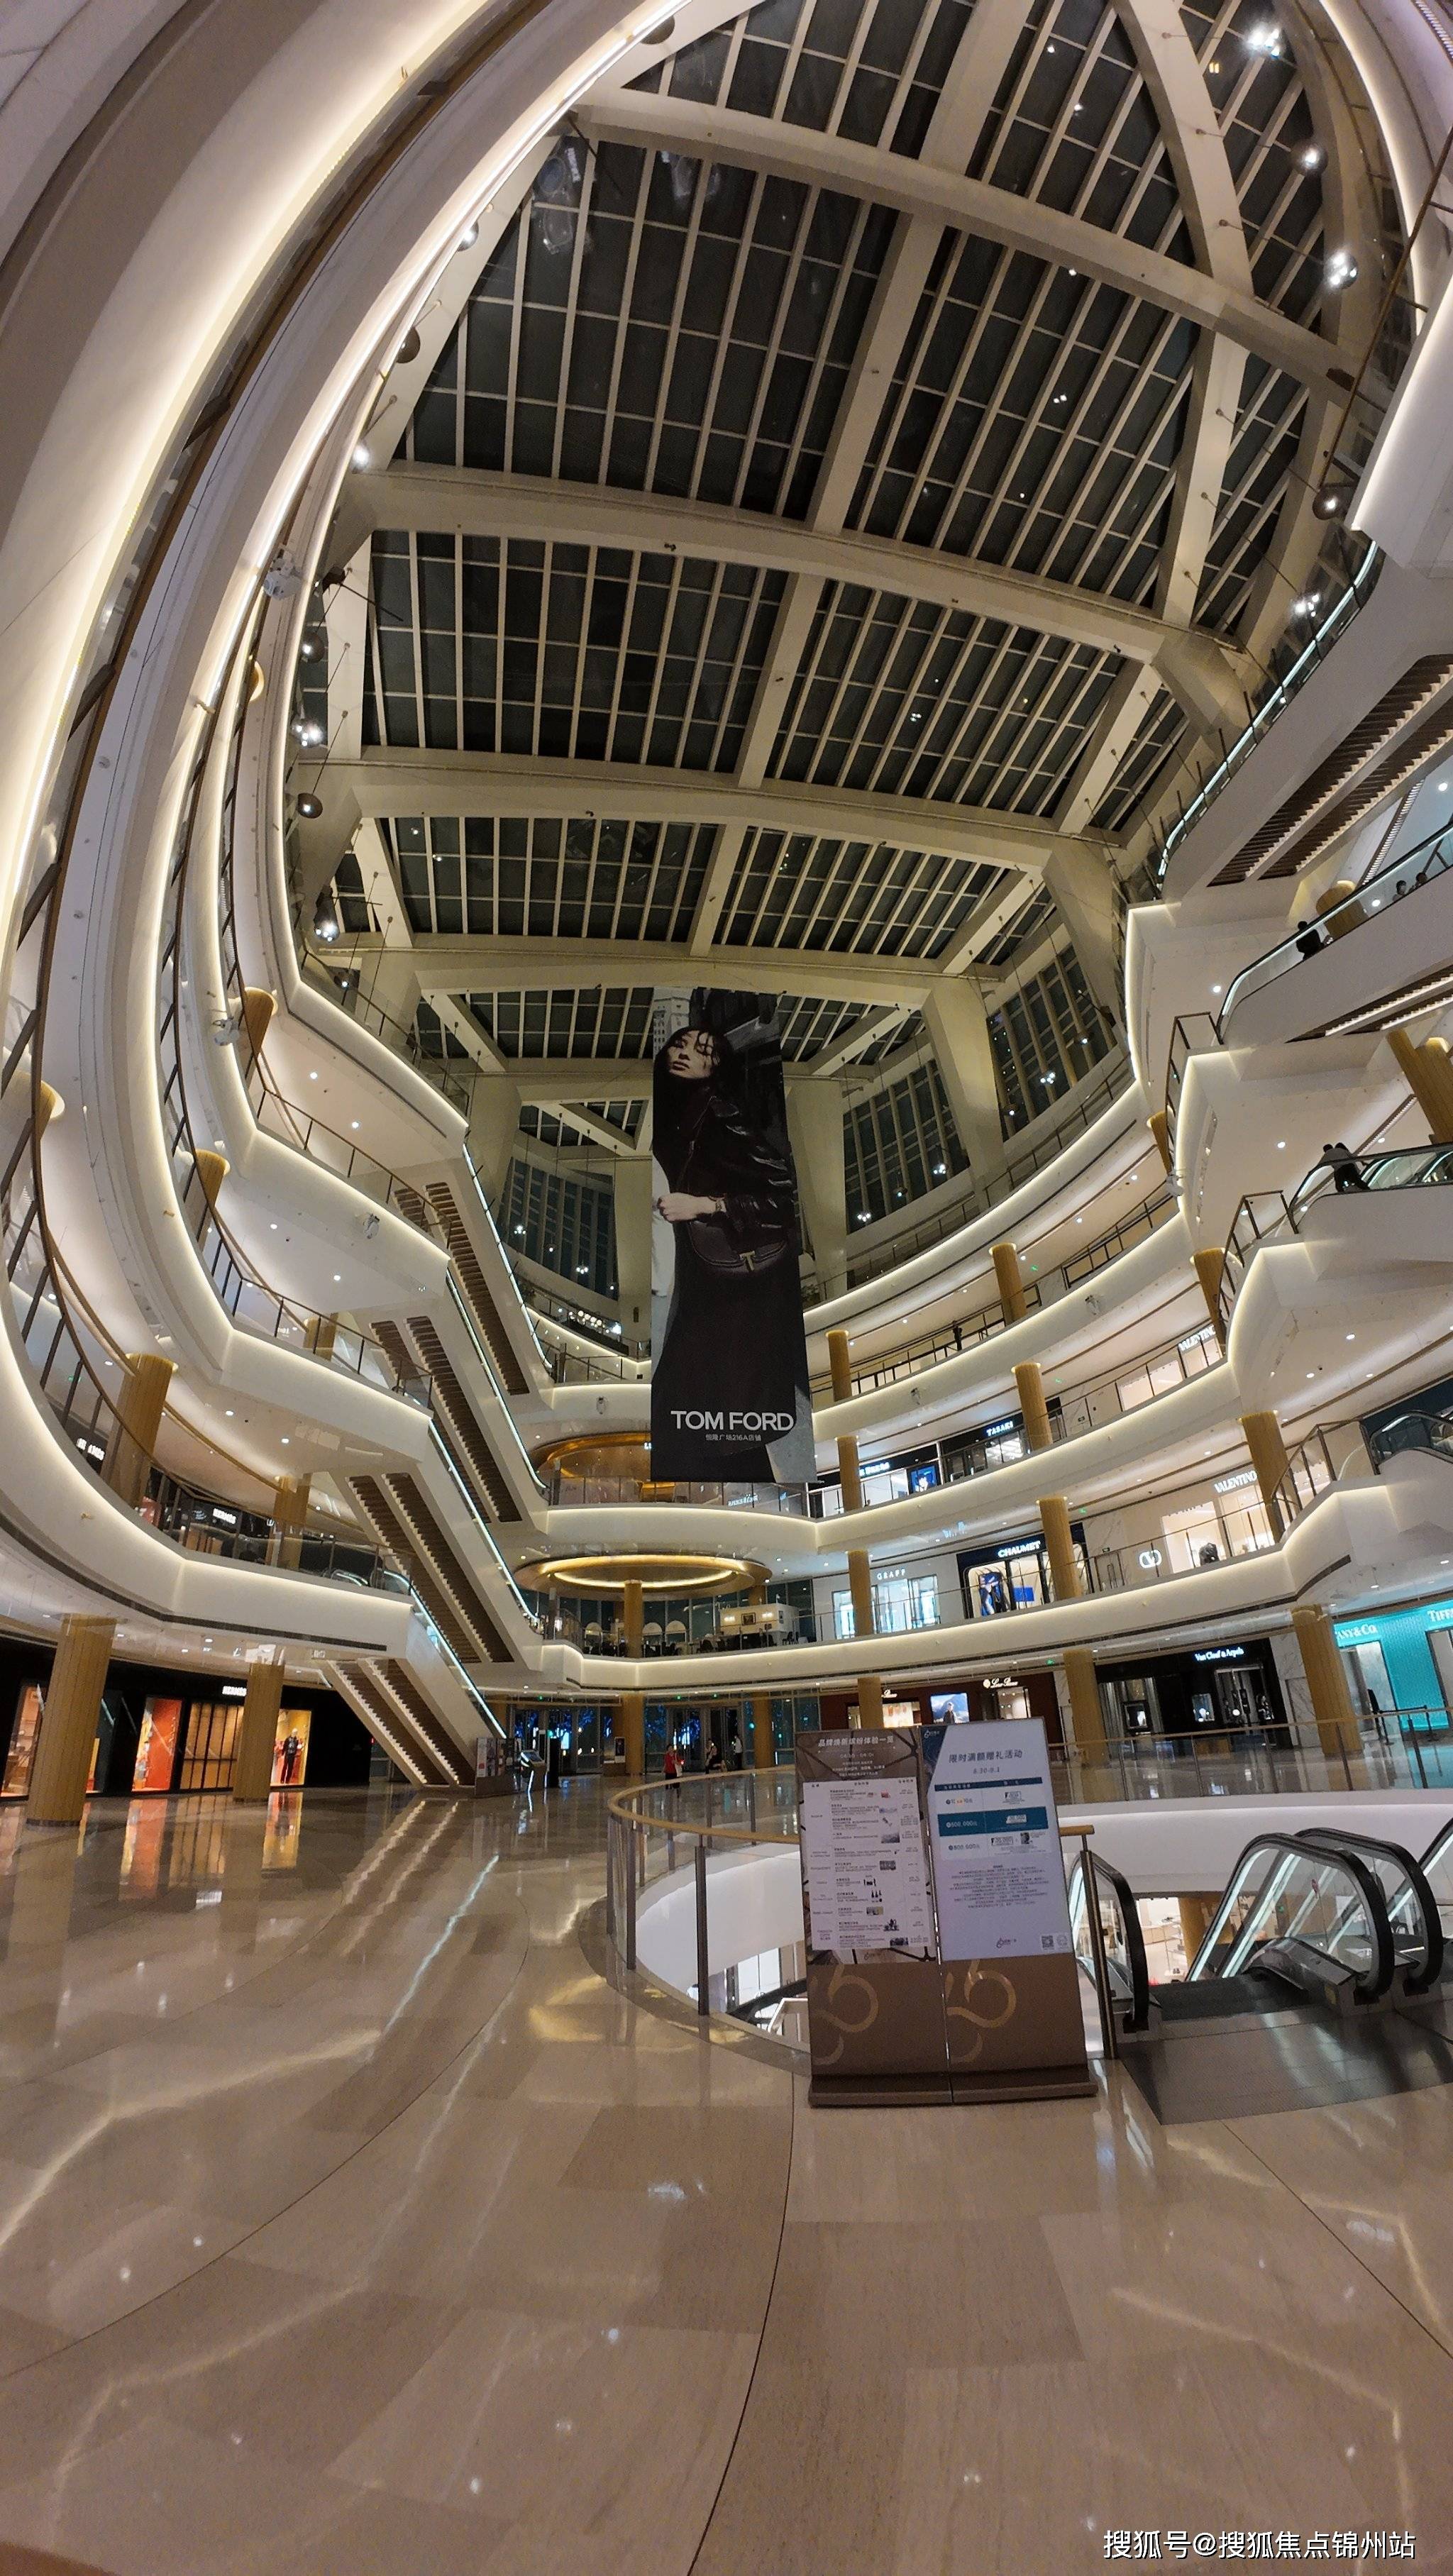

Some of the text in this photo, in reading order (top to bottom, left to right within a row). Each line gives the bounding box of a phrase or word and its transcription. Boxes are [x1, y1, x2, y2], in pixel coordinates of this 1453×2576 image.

[670, 1410, 794, 1431] TOM FORD
[986, 1421, 1013, 1437] TASAKI
[1214, 1470, 1258, 1493] VALENTINO
[998, 1540, 1041, 1558] CHAUMET
[876, 1569, 905, 1581] GRAFF
[949, 1749, 1022, 1764] 限时满额赠礼活动
